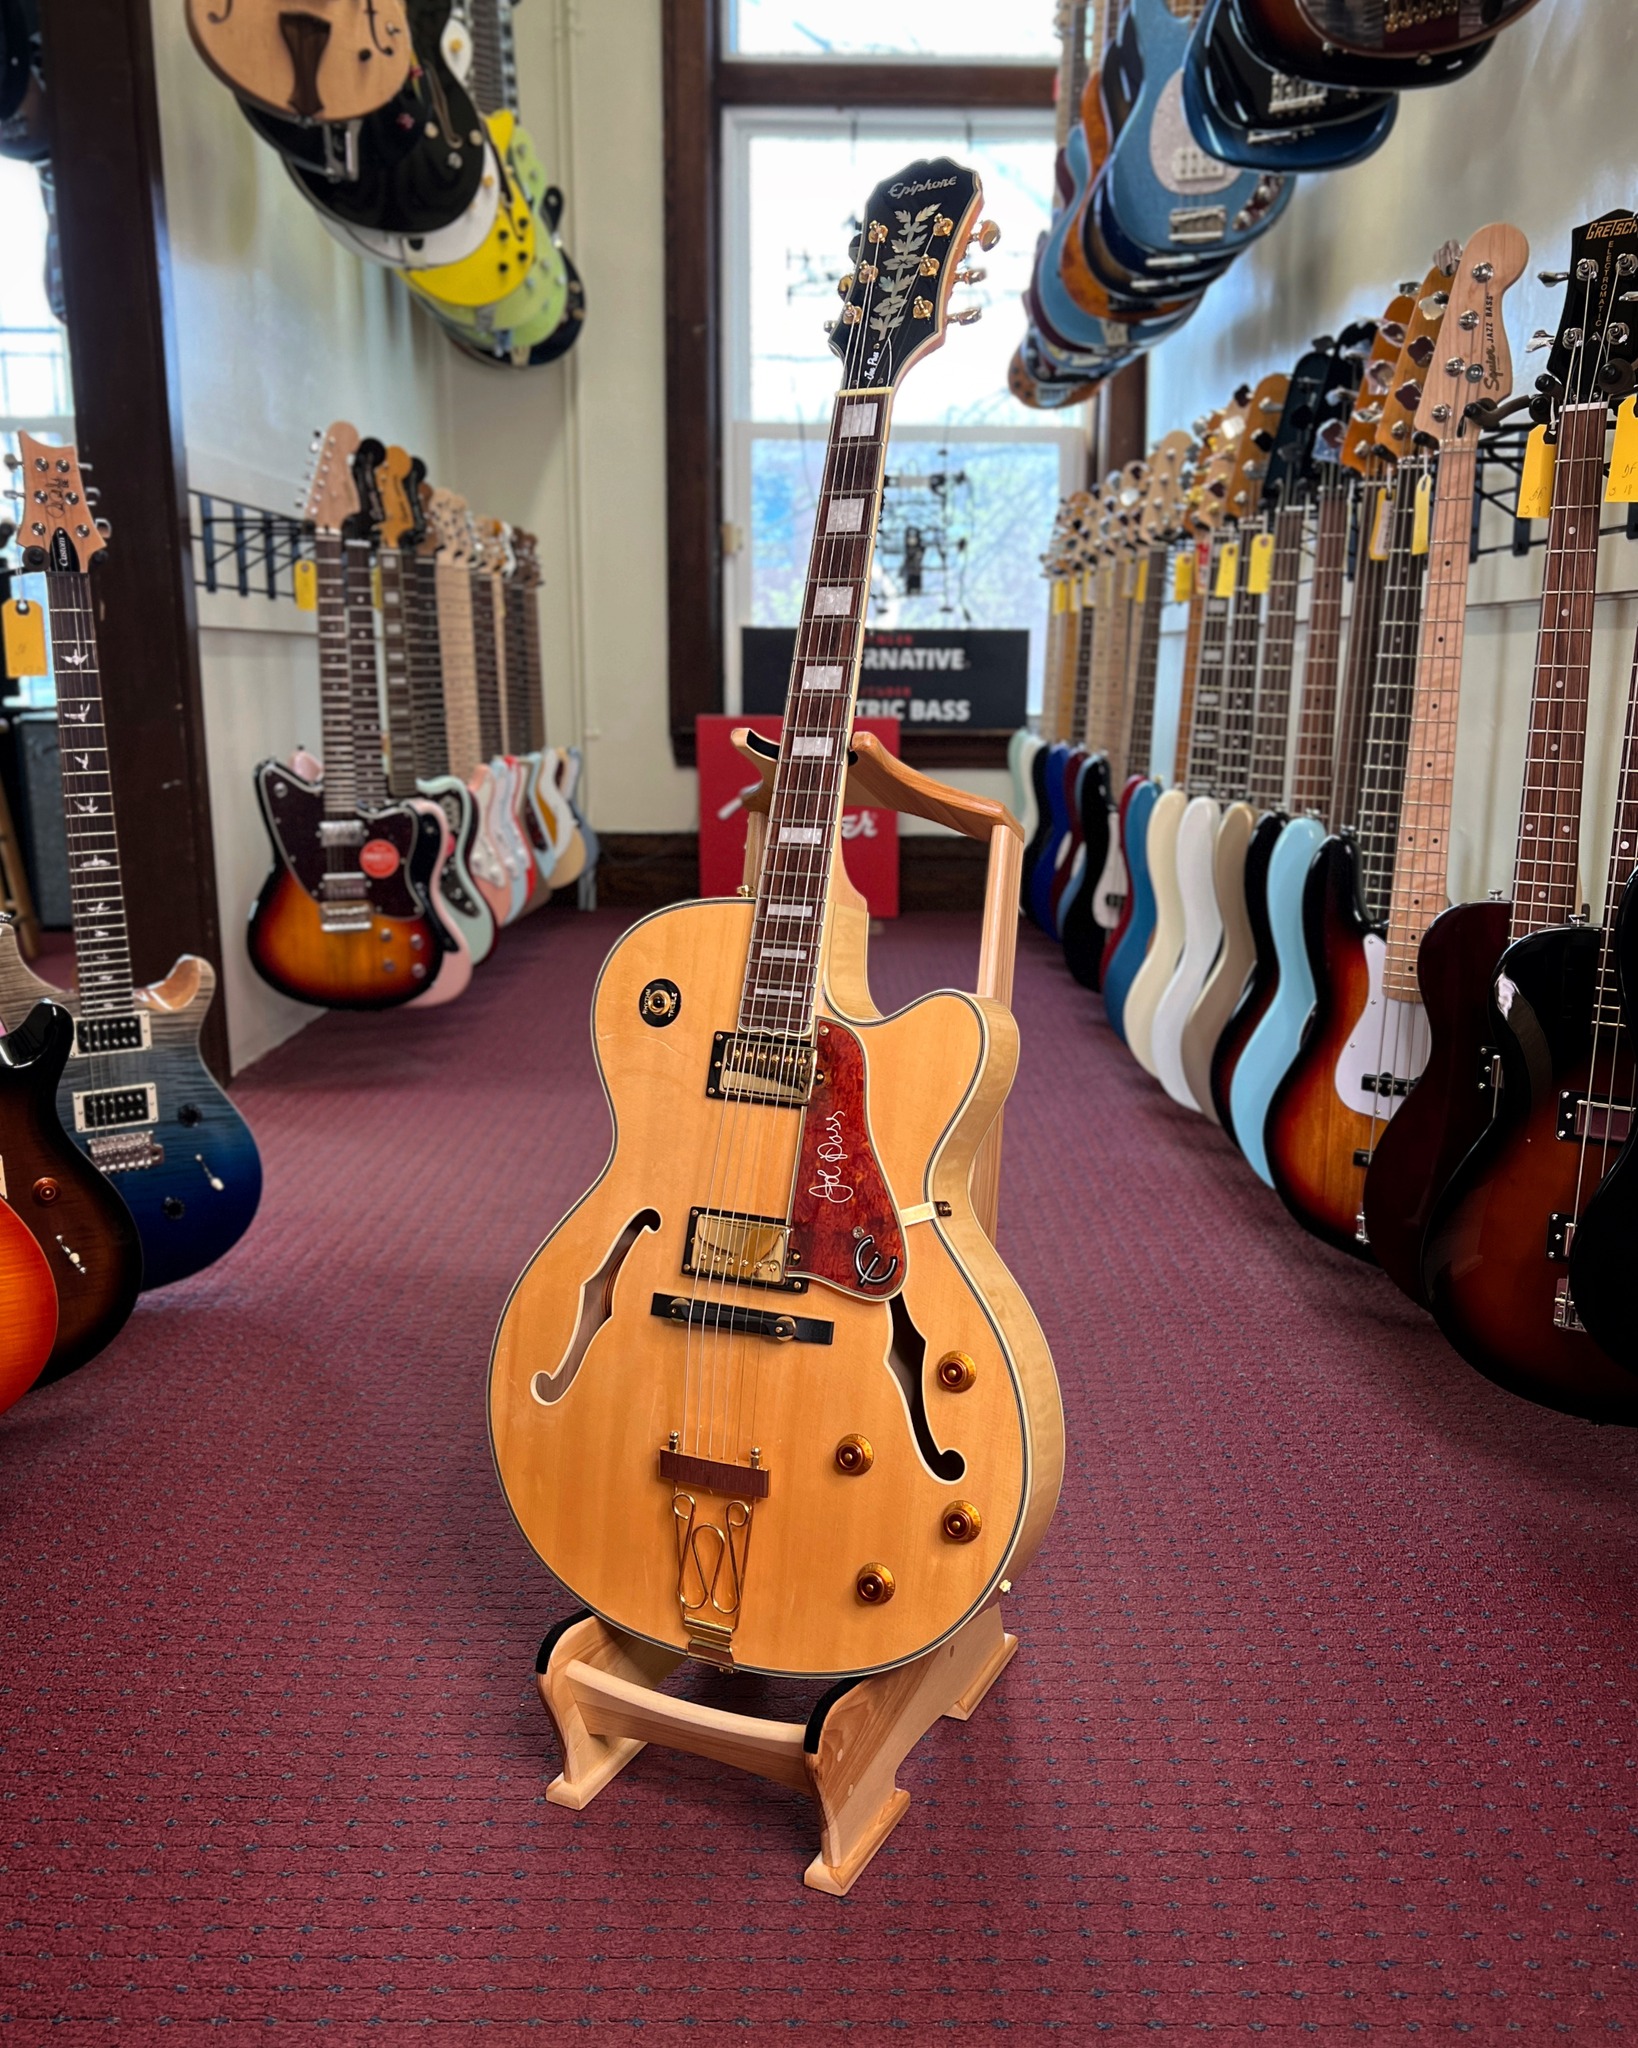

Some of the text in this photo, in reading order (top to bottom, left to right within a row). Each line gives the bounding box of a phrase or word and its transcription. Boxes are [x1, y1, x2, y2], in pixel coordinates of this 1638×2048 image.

[887, 176, 958, 200] Epiphone
[1595, 240, 1615, 327] ELECTROMATIC
[1483, 295, 1504, 391] Squier JAZZ BASS
[58, 537, 70, 567] Custom
[862, 647, 965, 671] RNATIVE
[855, 699, 970, 721] TRIC BASS
